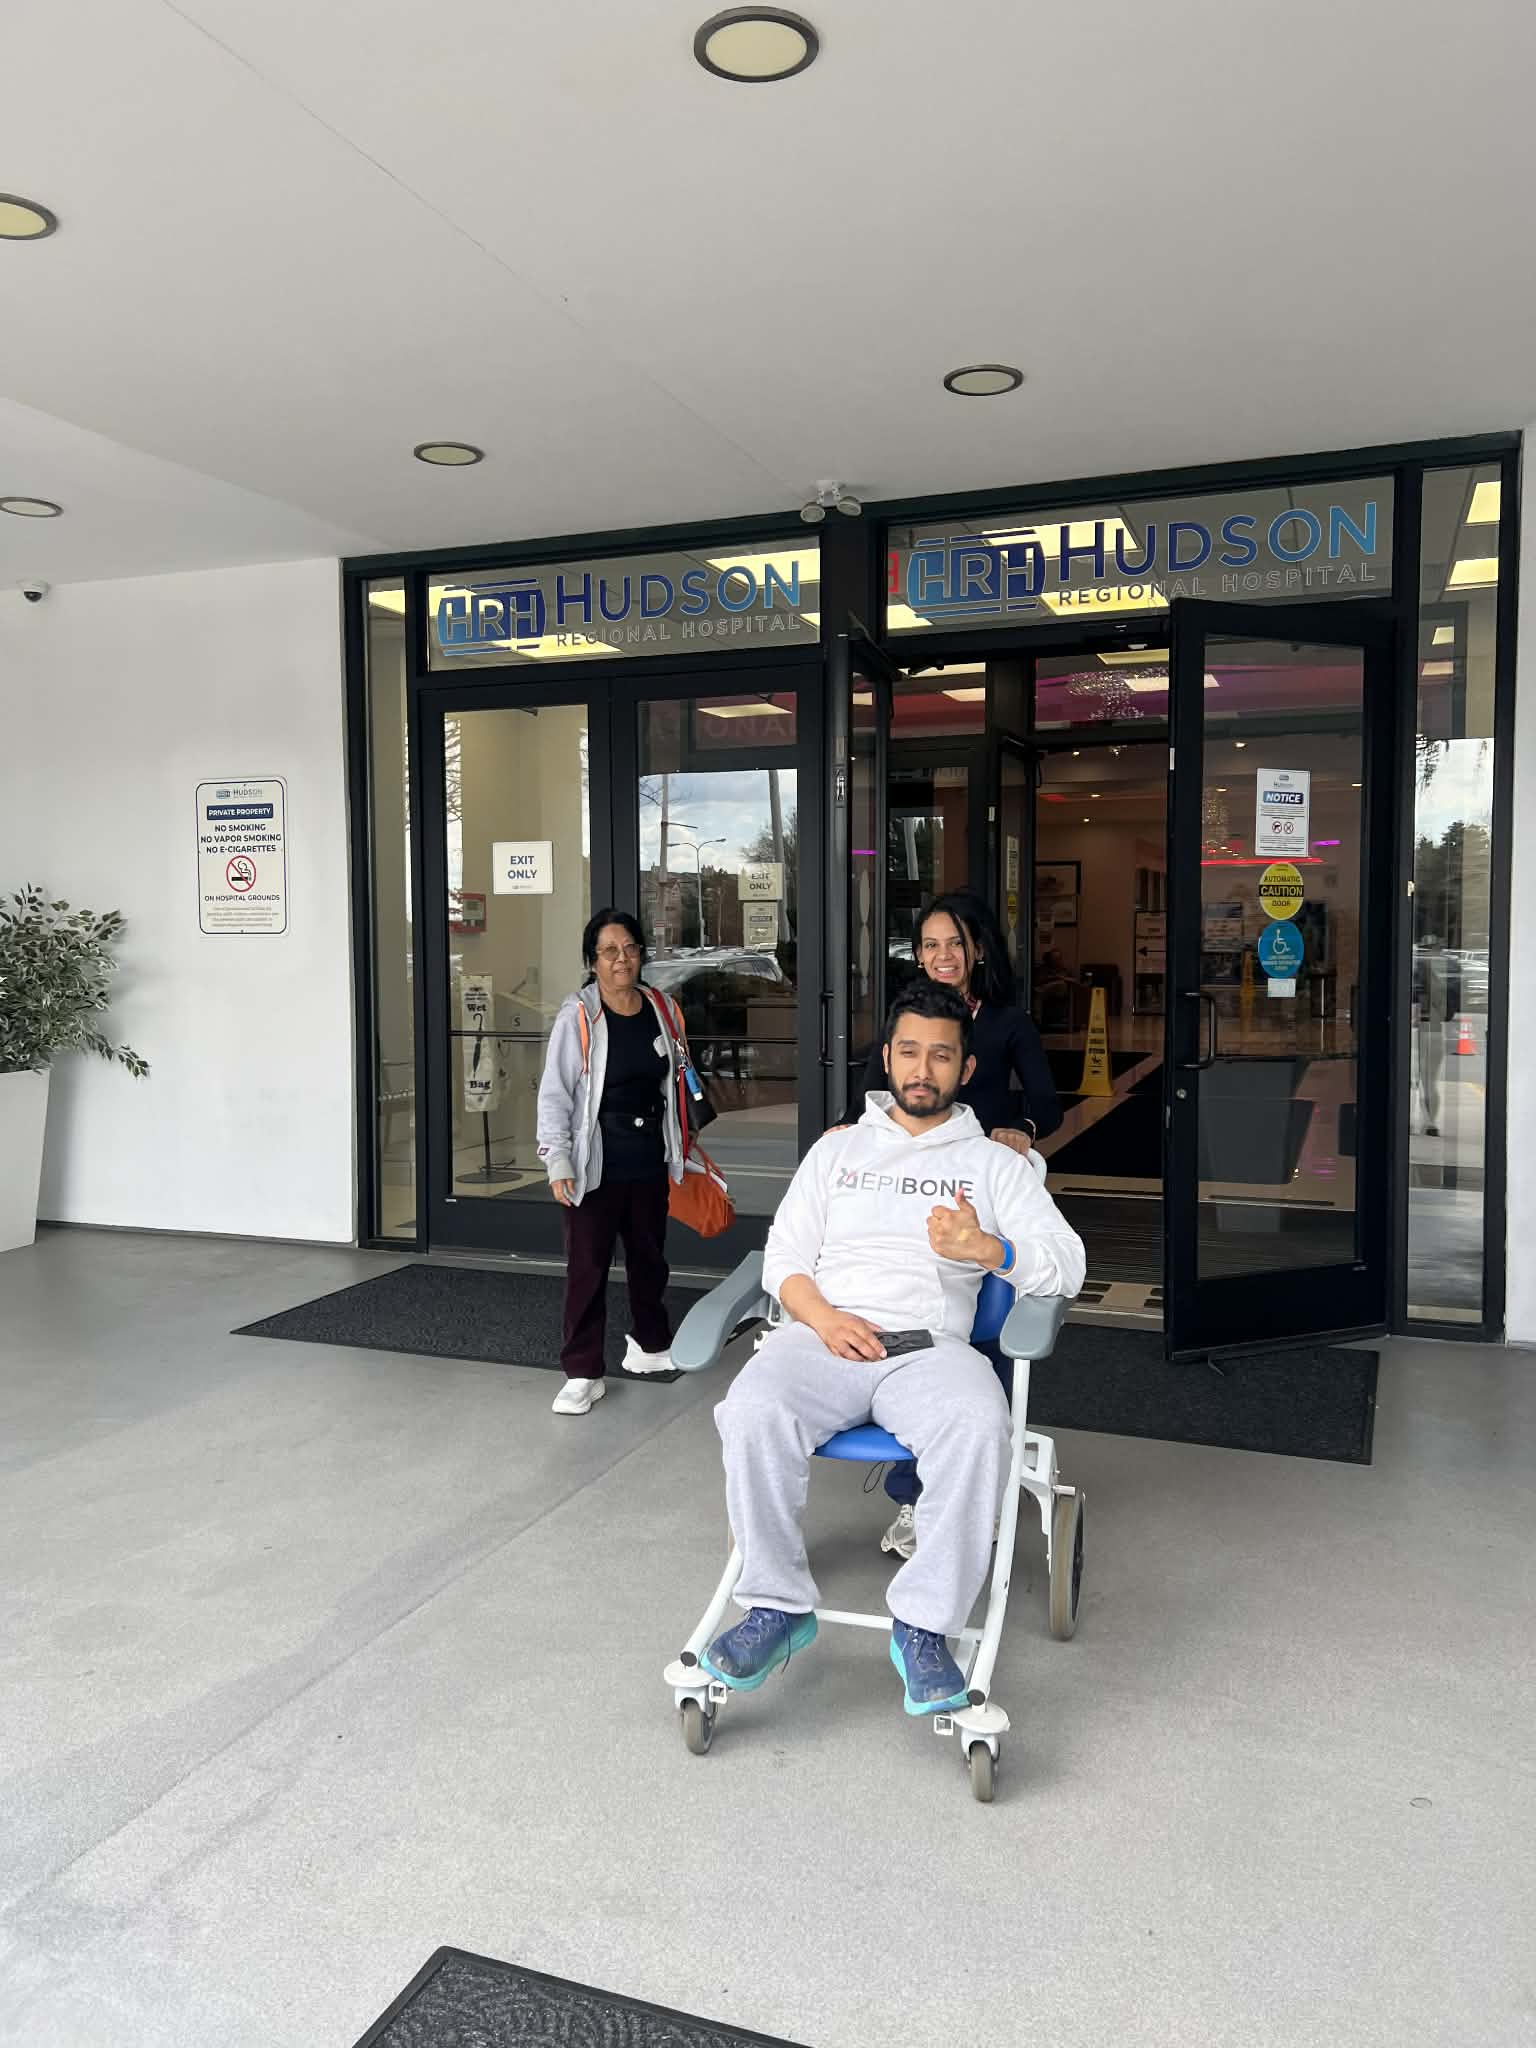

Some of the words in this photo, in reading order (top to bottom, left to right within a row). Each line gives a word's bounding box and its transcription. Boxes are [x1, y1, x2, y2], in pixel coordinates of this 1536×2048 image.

[1057, 501, 1377, 583] HUDSON
[916, 546, 1037, 602] HRH
[1057, 577, 1206, 608] REGIONAL
[1221, 562, 1377, 593] HOSPITAL
[555, 560, 800, 626] HUDSON
[445, 591, 539, 643] HRH
[556, 626, 671, 648] REGIONAL
[681, 613, 801, 640] HOSPITAL
[233, 788, 263, 796] HUDSON
[1265, 792, 1301, 803] NOTICE
[208, 808, 236, 817] PRIVATE
[236, 807, 271, 816] PROPERTY
[214, 824, 227, 832] NO
[228, 823, 266, 832] SMOKING
[200, 835, 212, 843] NO
[214, 834, 242, 843] VAPOR
[243, 833, 282, 842] SMOKING
[206, 845, 218, 854] NO
[220, 844, 277, 853] E-CIGARETTES
[510, 855, 535, 865] EXIT
[507, 869, 538, 880] ONLY
[1264, 875, 1301, 883] AUTOMATIC
[749, 882, 772, 890] ONLY
[1260, 886, 1303, 897] CAUTION
[860, 1171, 974, 1200] EPIBONE
